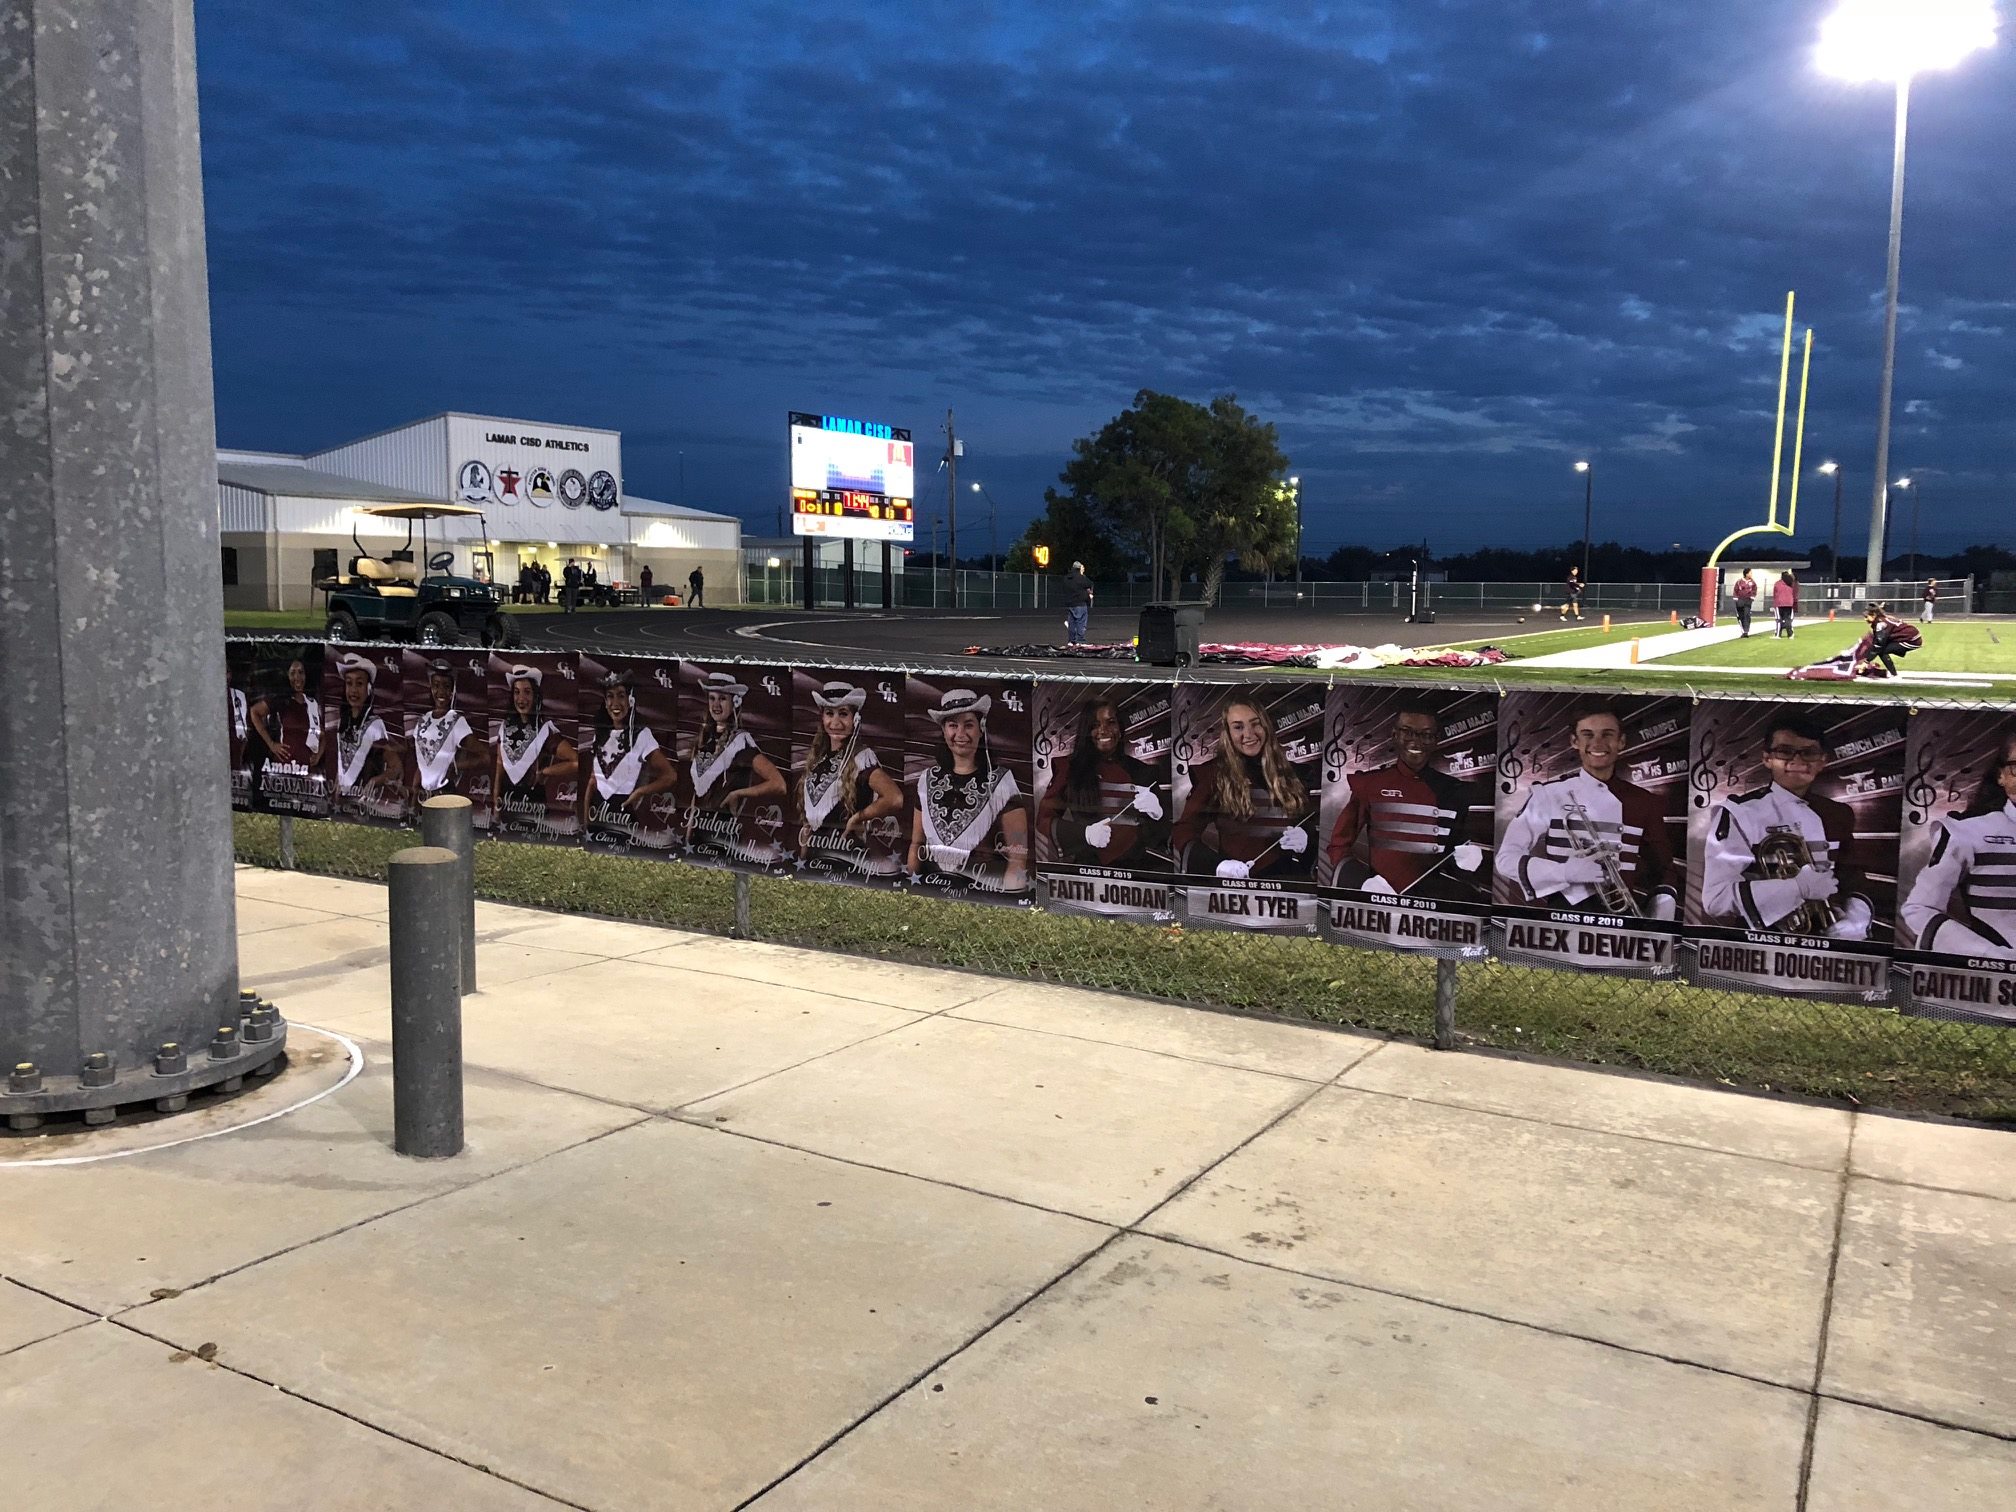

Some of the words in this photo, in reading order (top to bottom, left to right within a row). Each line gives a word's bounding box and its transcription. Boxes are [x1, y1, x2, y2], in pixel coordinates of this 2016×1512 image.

[822, 415, 862, 434] LAMAR
[865, 422, 892, 440] CISD
[486, 432, 516, 445] LAMAR
[520, 436, 541, 448] CISD
[545, 438, 589, 452] ATHLETICS
[1129, 708, 1148, 724] DRUM
[1147, 699, 1170, 716] MAJOR
[1277, 712, 1298, 728] DRUM
[1296, 703, 1322, 720] MAJOR
[1444, 719, 1467, 737] DRUM
[1467, 710, 1495, 729] MAJOR
[1638, 719, 1679, 740] TRUMPET
[1834, 736, 1873, 759] FRENCH
[1872, 727, 1901, 748] HORN
[261, 757, 309, 776] Amaka
[1477, 752, 1498, 766] BAND
[1666, 759, 1688, 774] BAND
[495, 791, 546, 814] Madison
[588, 800, 631, 826] Alexia
[680, 806, 743, 840] Bridgette
[697, 844, 719, 856] Class
[798, 828, 855, 852] Caroline
[809, 860, 833, 871] Class
[847, 846, 880, 884] Hope
[1079, 867, 1101, 877] CLASS
[1103, 870, 1112, 878] OF
[1113, 870, 1132, 879] 2019
[925, 873, 952, 887] Class
[1221, 879, 1246, 889] CLASS
[1248, 881, 1258, 889] OF
[1260, 882, 1282, 890] 2019
[1049, 879, 1095, 902] FAITH
[1100, 883, 1167, 910] JORDAN
[1207, 892, 1251, 916] ALEX
[1254, 895, 1299, 920] TYER
[1370, 894, 1398, 905] CLASS
[1400, 898, 1411, 907] OF
[1413, 899, 1437, 910] 2019
[1331, 906, 1392, 935] JALEN
[1397, 913, 1477, 945] ARCHER
[1550, 911, 1581, 923] CLASS
[1583, 915, 1595, 925] OF
[1597, 916, 1624, 927] 2019
[1461, 945, 1489, 957] Neil's
[1508, 924, 1571, 954] ALEX
[1577, 931, 1669, 963] DEWEY
[1747, 933, 1781, 944] CLASS
[1784, 937, 1798, 946] OF
[1801, 937, 1830, 949] 2019
[1699, 944, 1769, 976] GABRIEL
[1774, 951, 1881, 987] DOUGHERTY
[1967, 958, 2006, 971] CLASS
[1912, 970, 1991, 1004] CAITLIN
